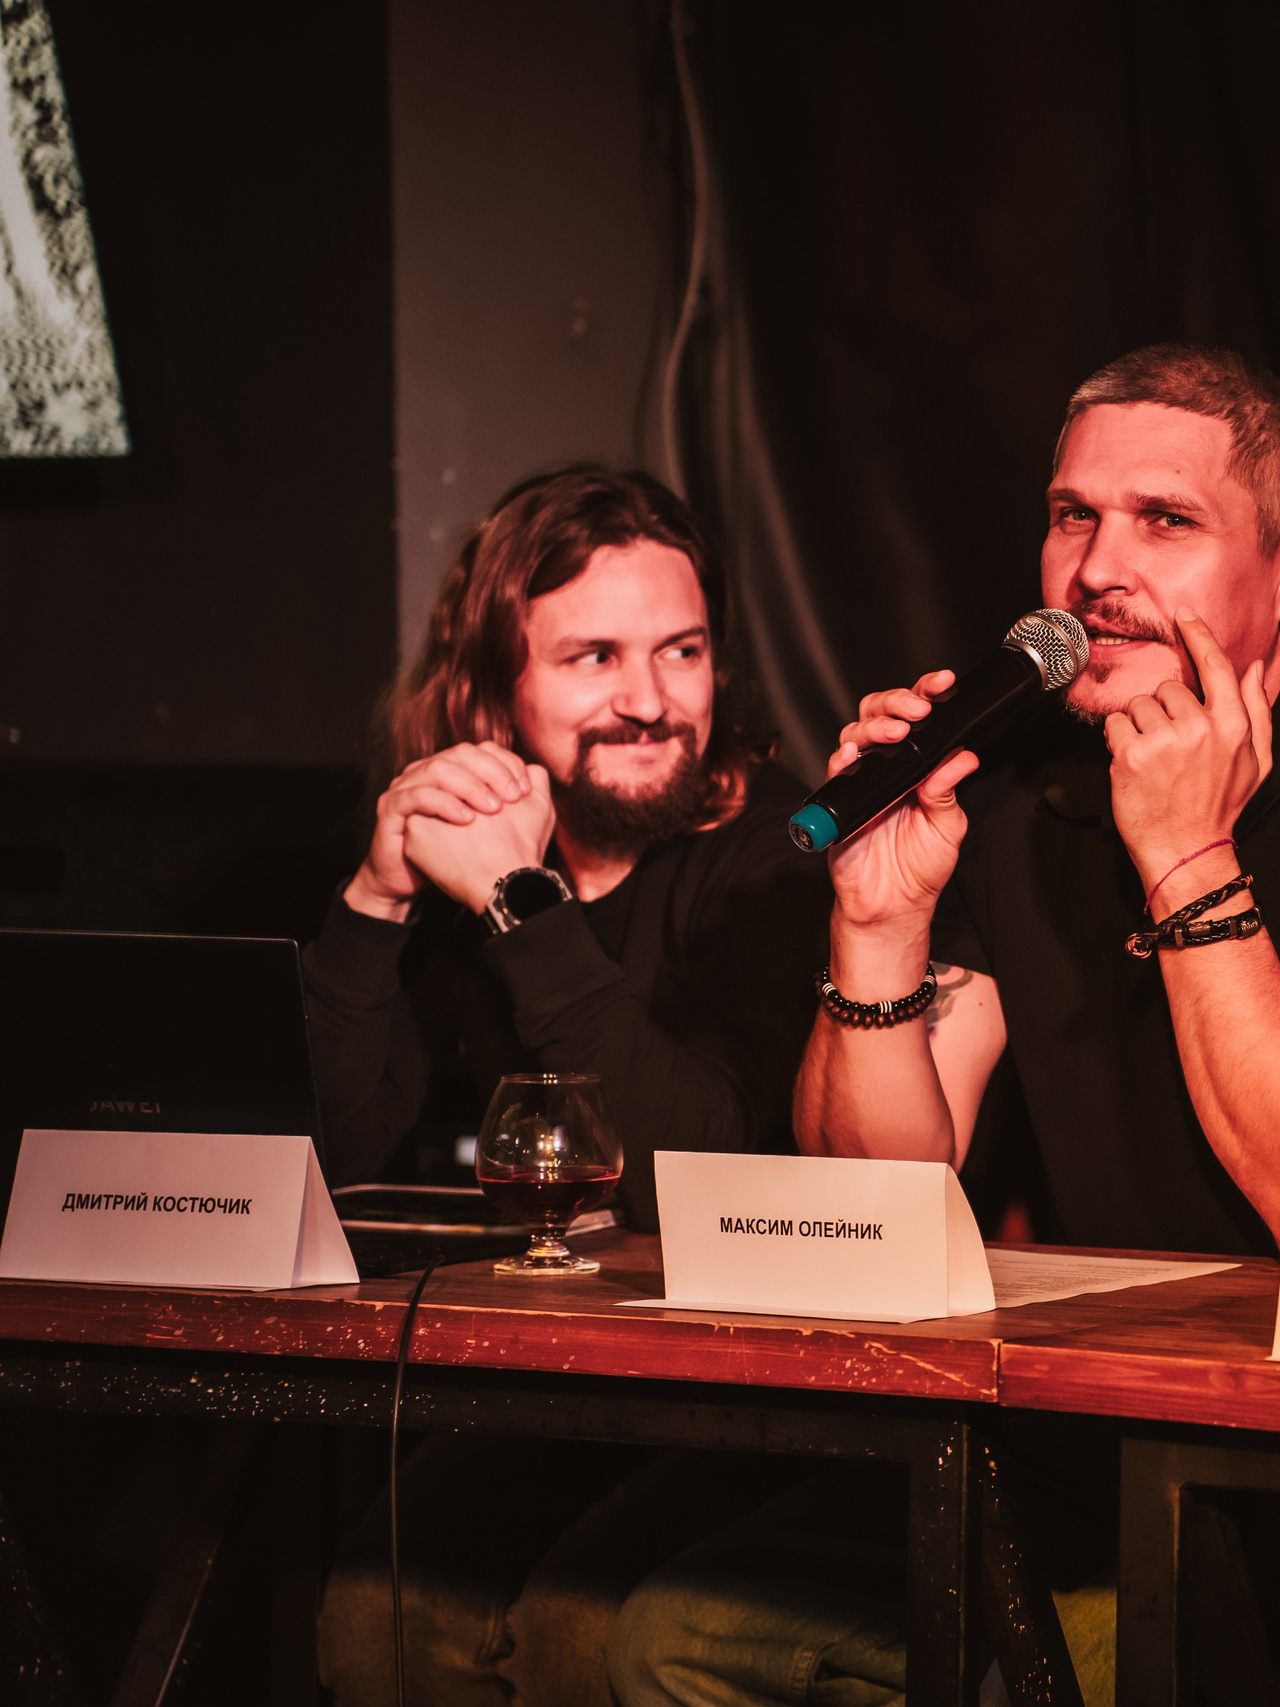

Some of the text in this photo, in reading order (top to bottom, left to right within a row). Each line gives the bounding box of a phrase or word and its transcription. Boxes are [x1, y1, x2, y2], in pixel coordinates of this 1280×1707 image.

[61, 1192, 252, 1215] ДМИТРИЙ КОСТЮЧИК
[720, 1217, 883, 1240] МАКСИМ ОЛЕЙНИК
